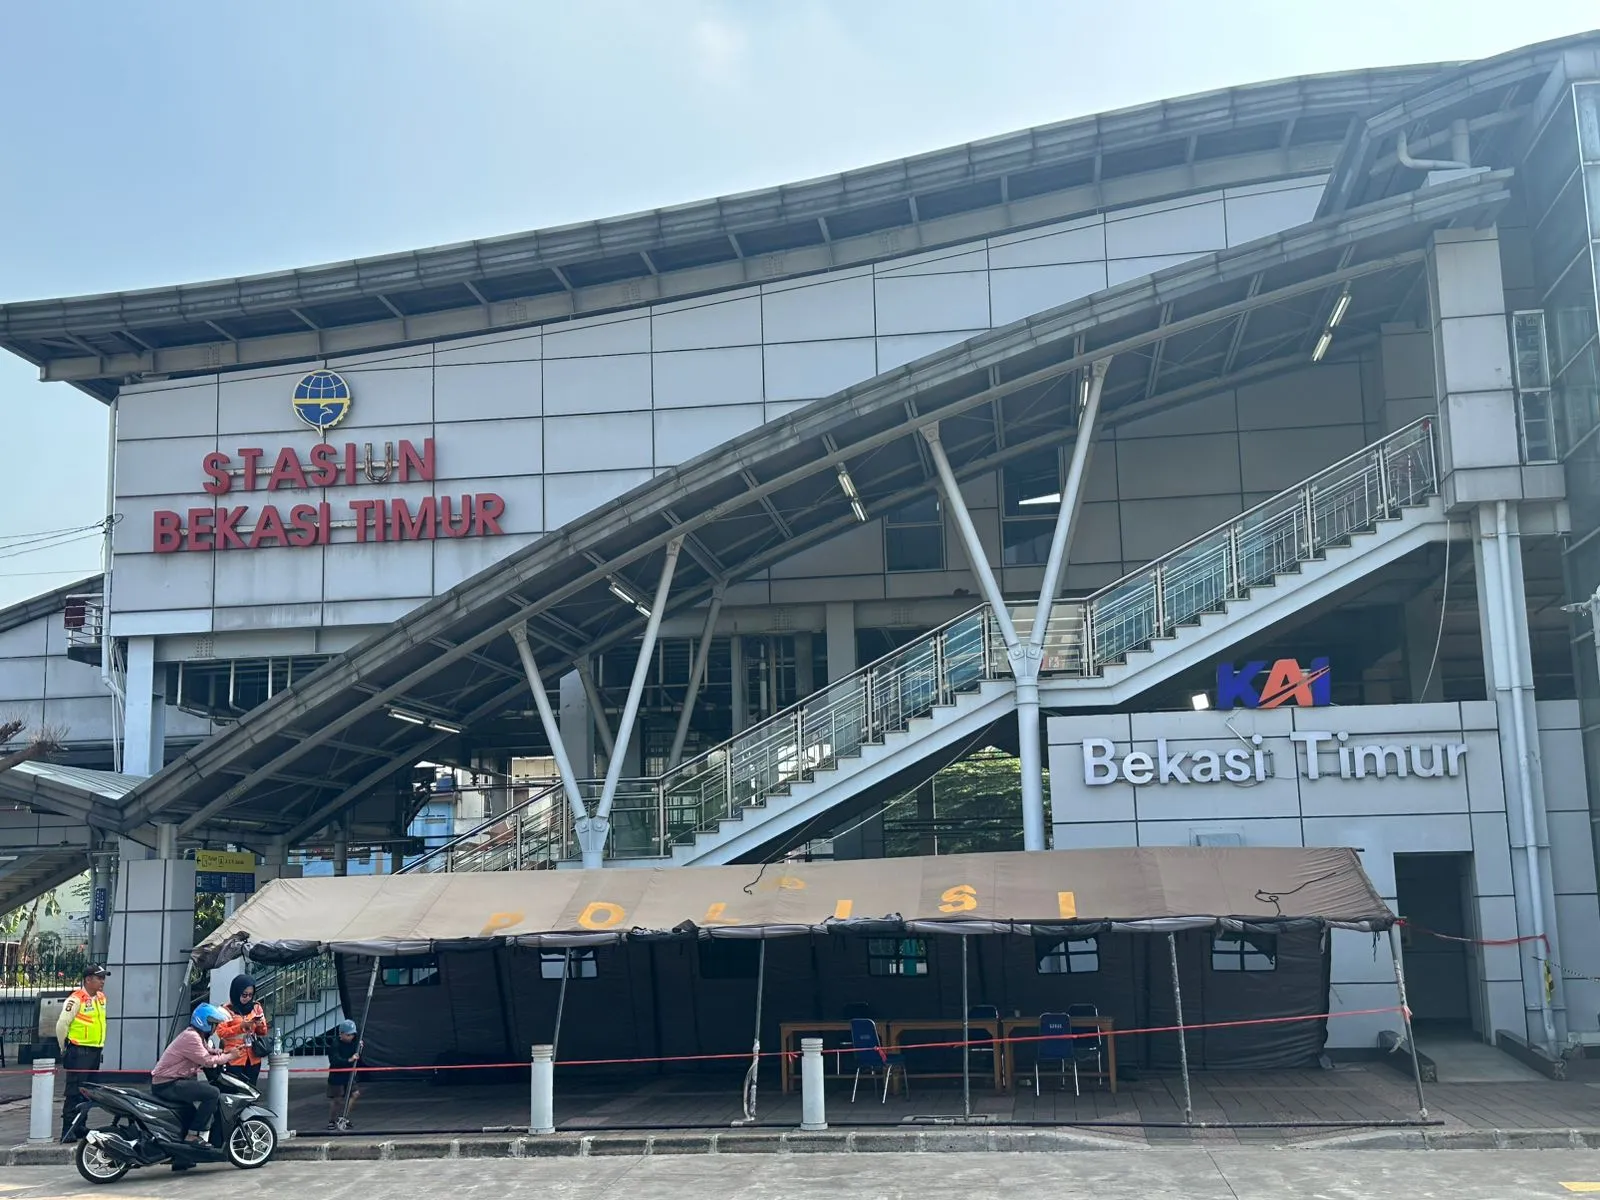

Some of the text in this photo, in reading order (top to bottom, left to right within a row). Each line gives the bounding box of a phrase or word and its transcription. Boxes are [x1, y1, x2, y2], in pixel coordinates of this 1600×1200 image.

[203, 437, 435, 495] STASIUN
[153, 493, 506, 553] BEKASI TIMUR
[1216, 656, 1331, 710] KAI
[1082, 731, 1469, 786] Bekasi Timur
